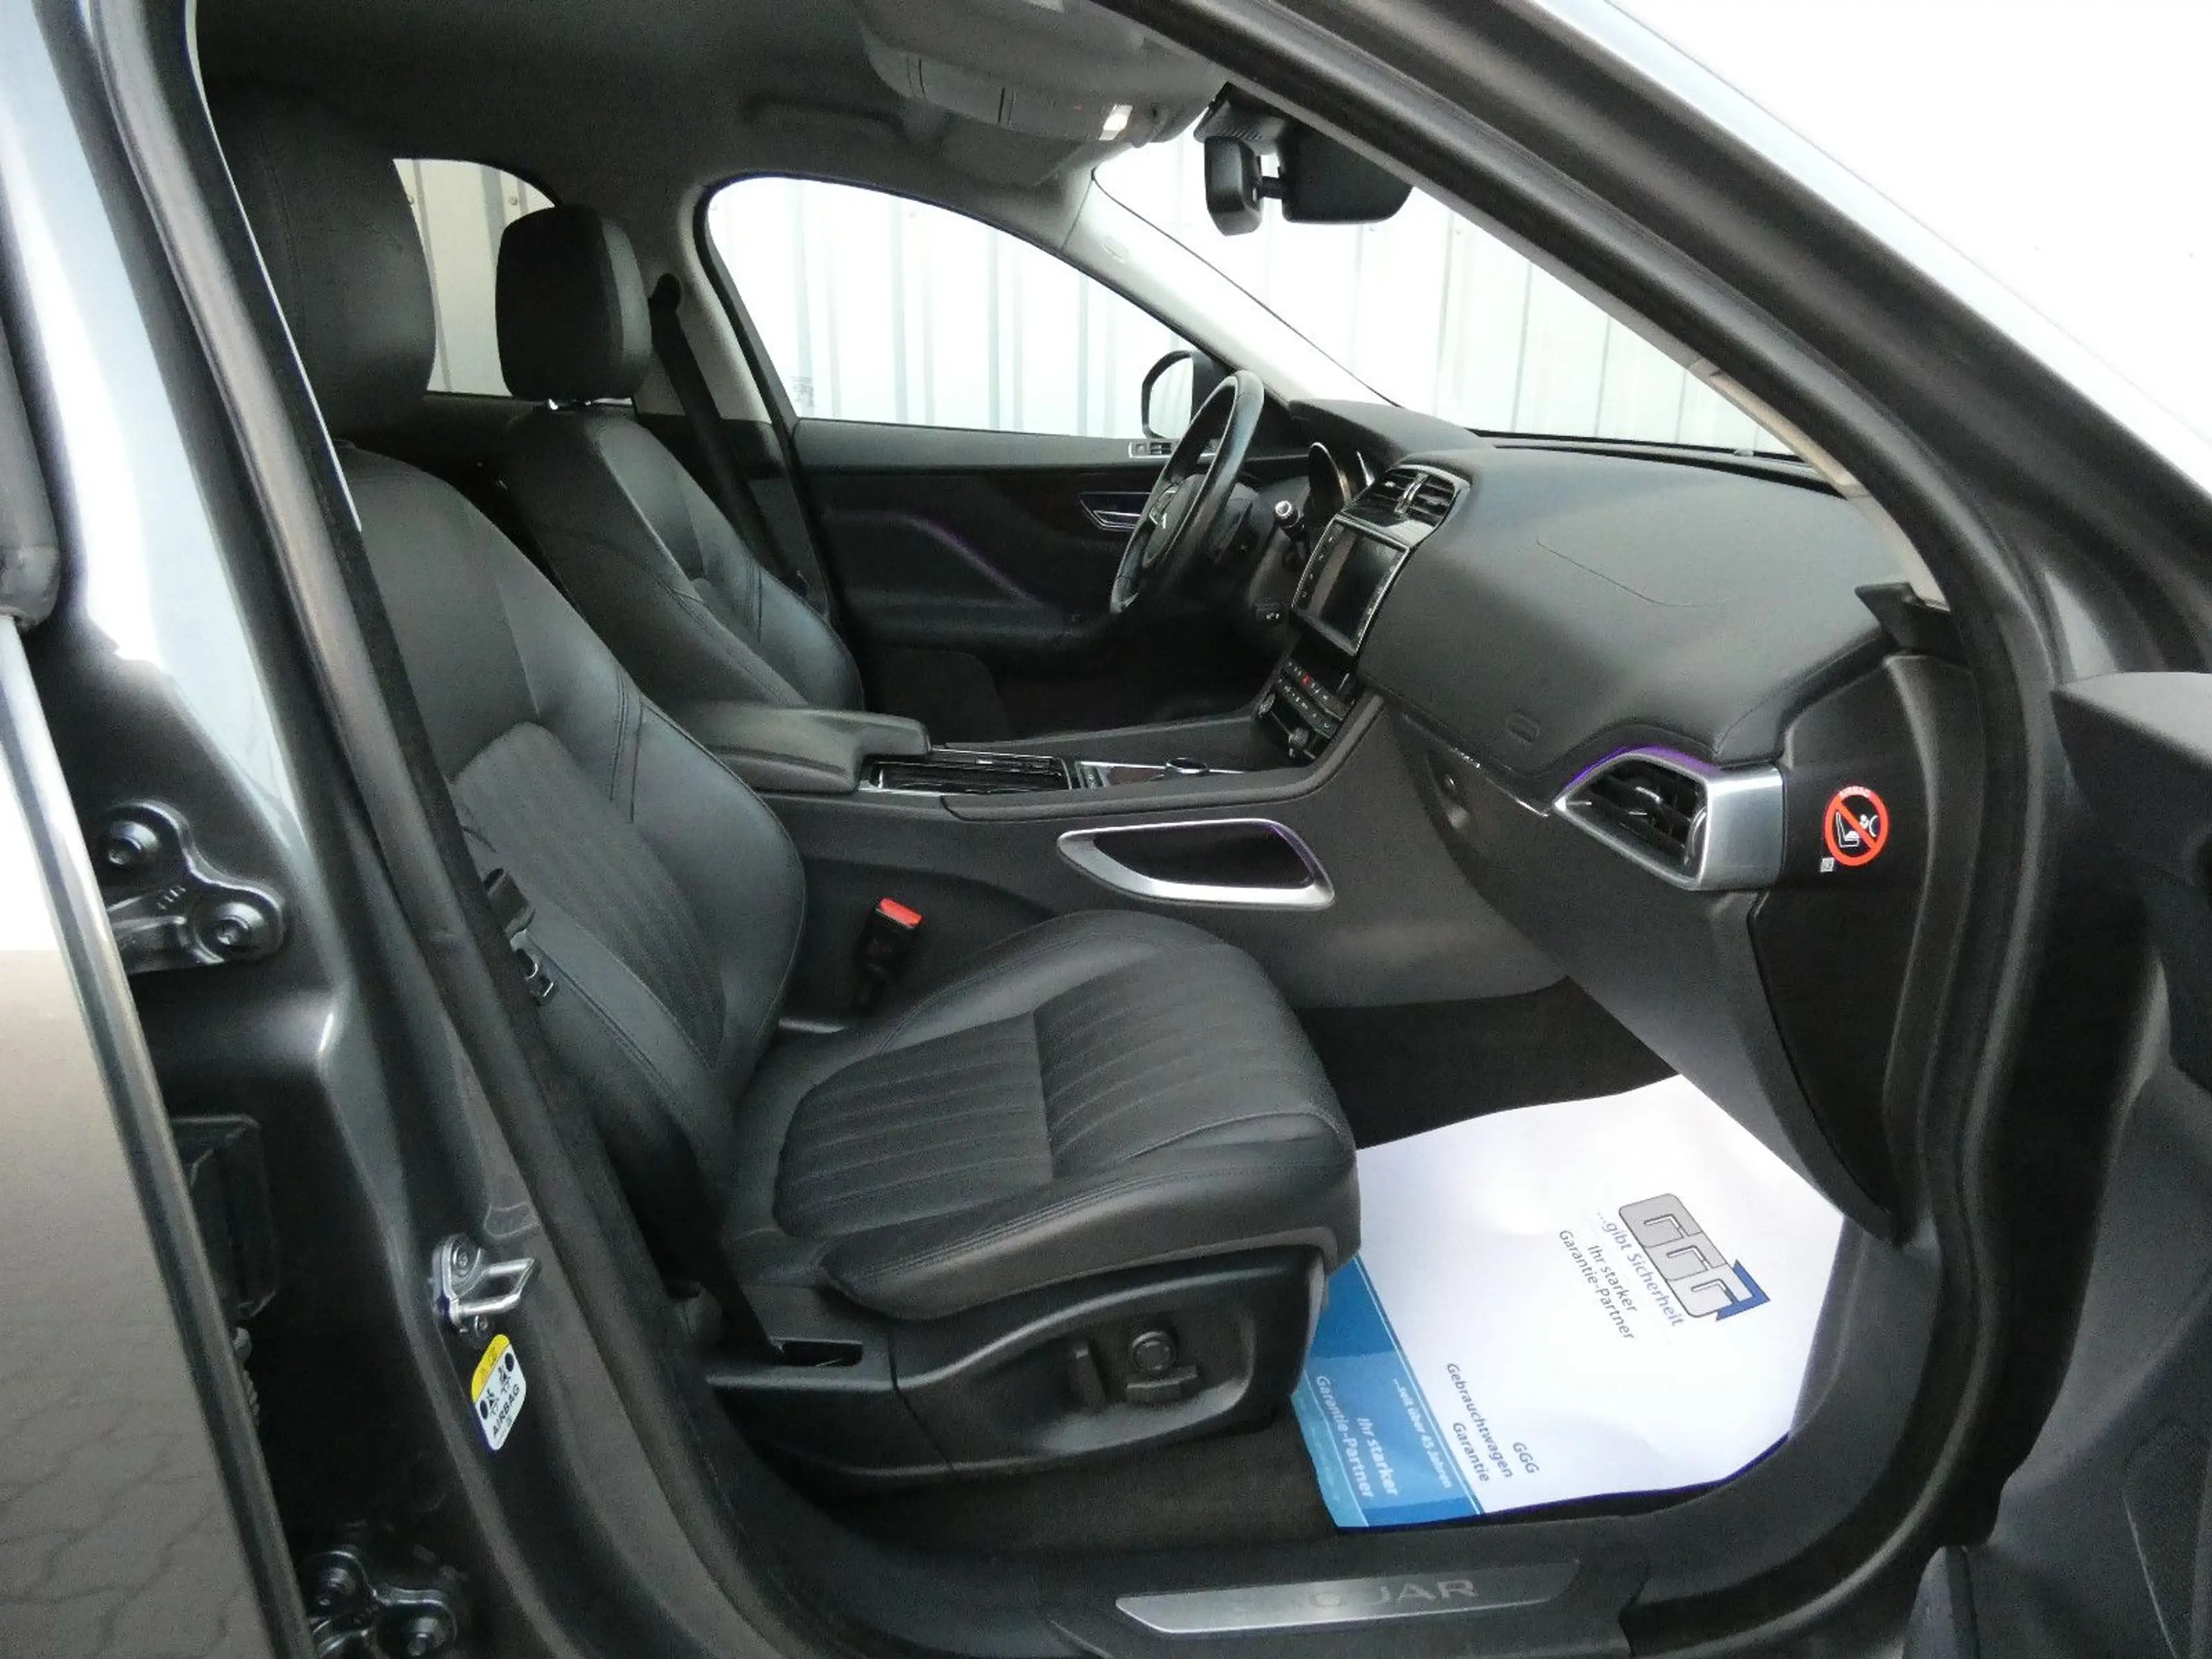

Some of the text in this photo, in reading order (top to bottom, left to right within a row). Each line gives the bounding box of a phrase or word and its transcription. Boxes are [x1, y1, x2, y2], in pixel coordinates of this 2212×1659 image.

[1559, 1230, 1635, 1339] Garantie-Partner
[1588, 1244, 1638, 1312] Ihr starker
[1626, 1252, 1684, 1327] Sicherheit
[493, 1383, 520, 1438] AIRBAG
[1317, 1376, 1374, 1498] Garantie-Partner
[1447, 1363, 1513, 1478] Gebrauchtwagen
[1357, 1417, 1398, 1495] Ihr starker
[1453, 1422, 1490, 1482] Garantie
[1512, 1442, 1540, 1474] GGG
